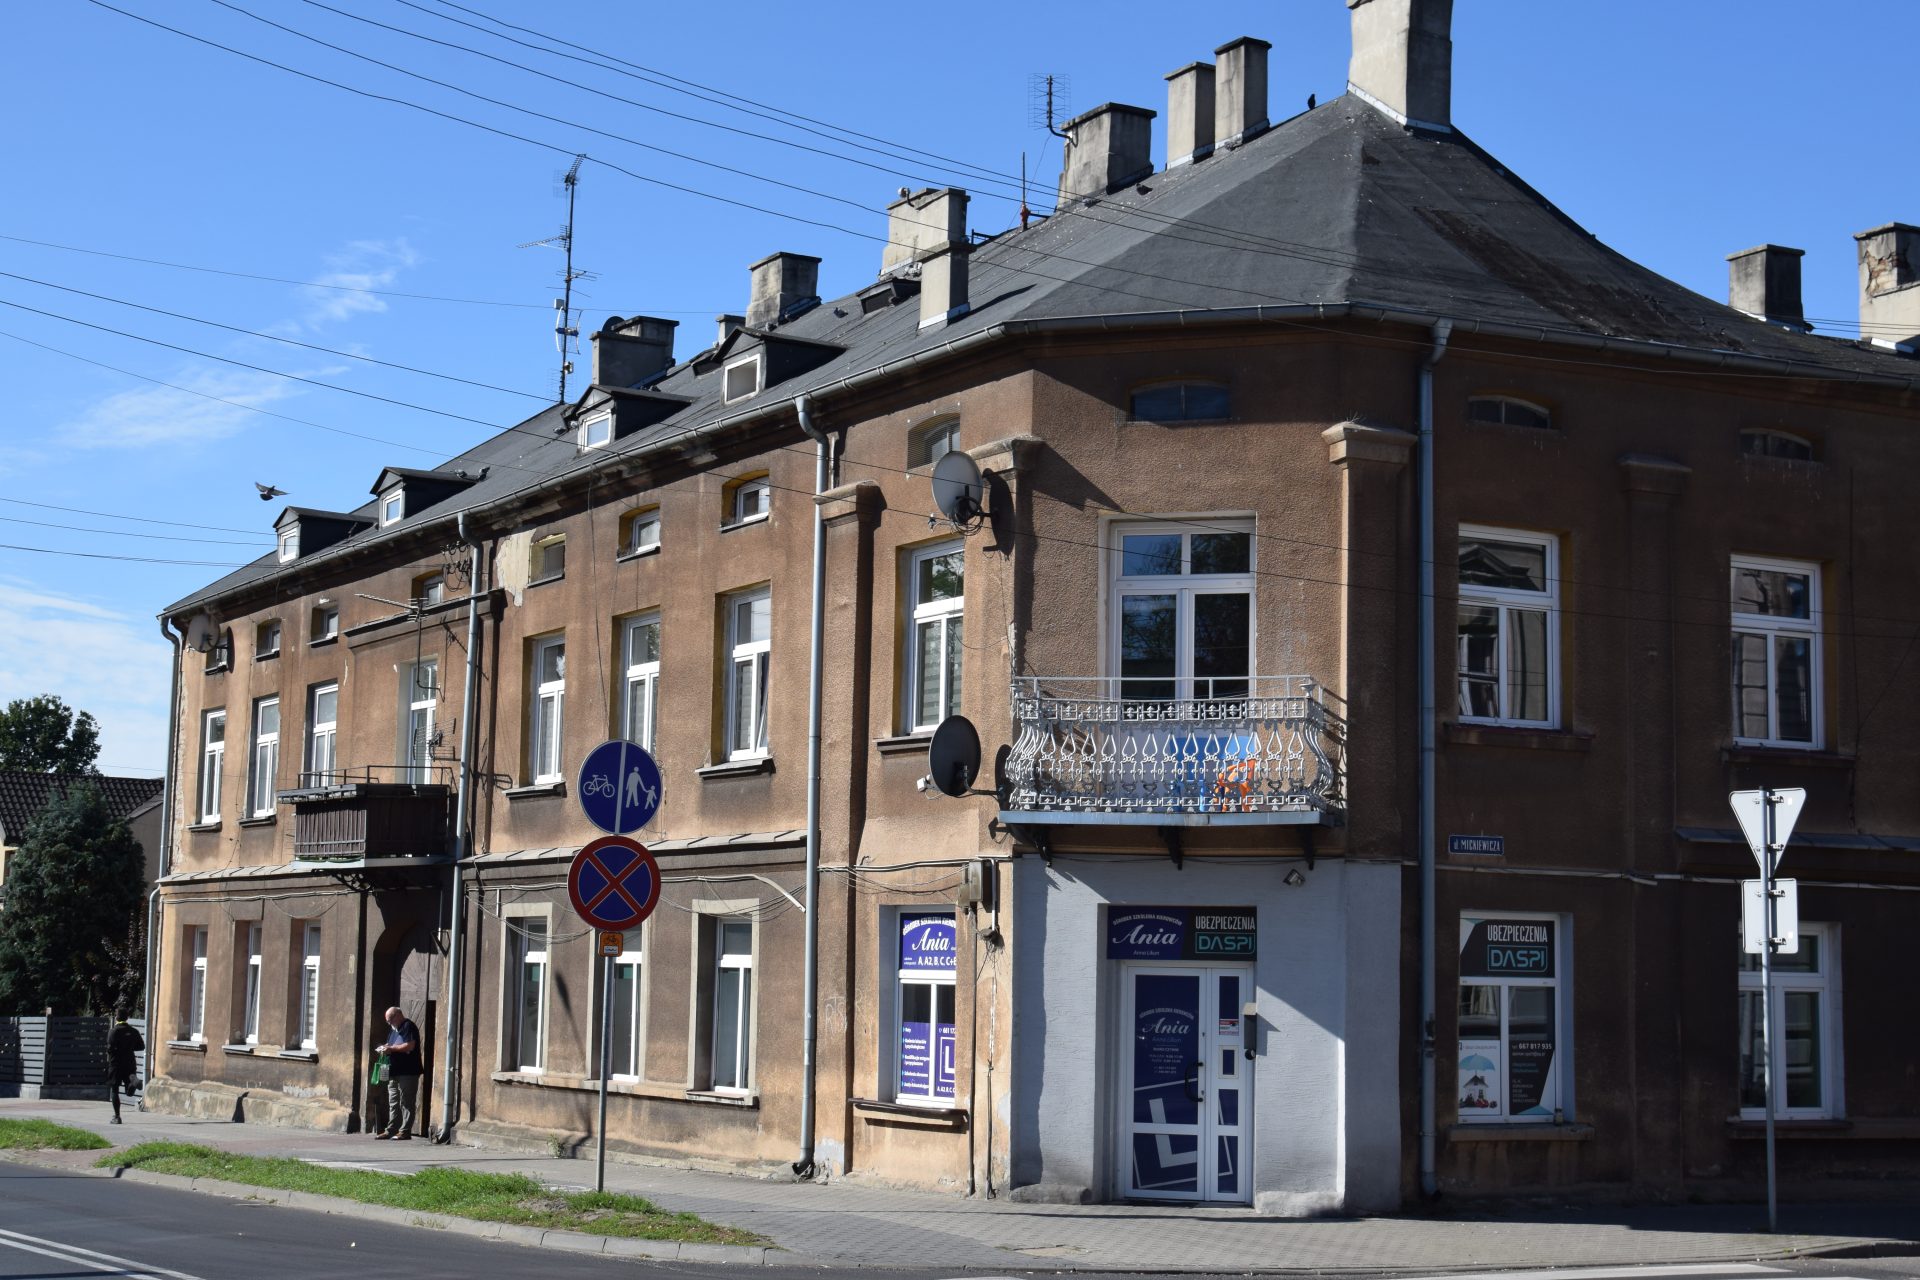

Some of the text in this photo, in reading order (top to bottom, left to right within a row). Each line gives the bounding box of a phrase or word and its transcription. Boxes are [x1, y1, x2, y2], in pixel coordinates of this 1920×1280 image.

[1460, 839, 1501, 852] MICKIEWICZA
[1195, 915, 1256, 930] UBEZPIECZENIA
[911, 927, 951, 951] Ania
[1112, 924, 1179, 945] Ania
[1487, 924, 1548, 943] UBEZPIECZENIA
[1199, 936, 1252, 950] DASPI
[1490, 949, 1545, 968] DASPI
[1142, 1017, 1190, 1034] Ania
[1541, 1042, 1552, 1050] 935
